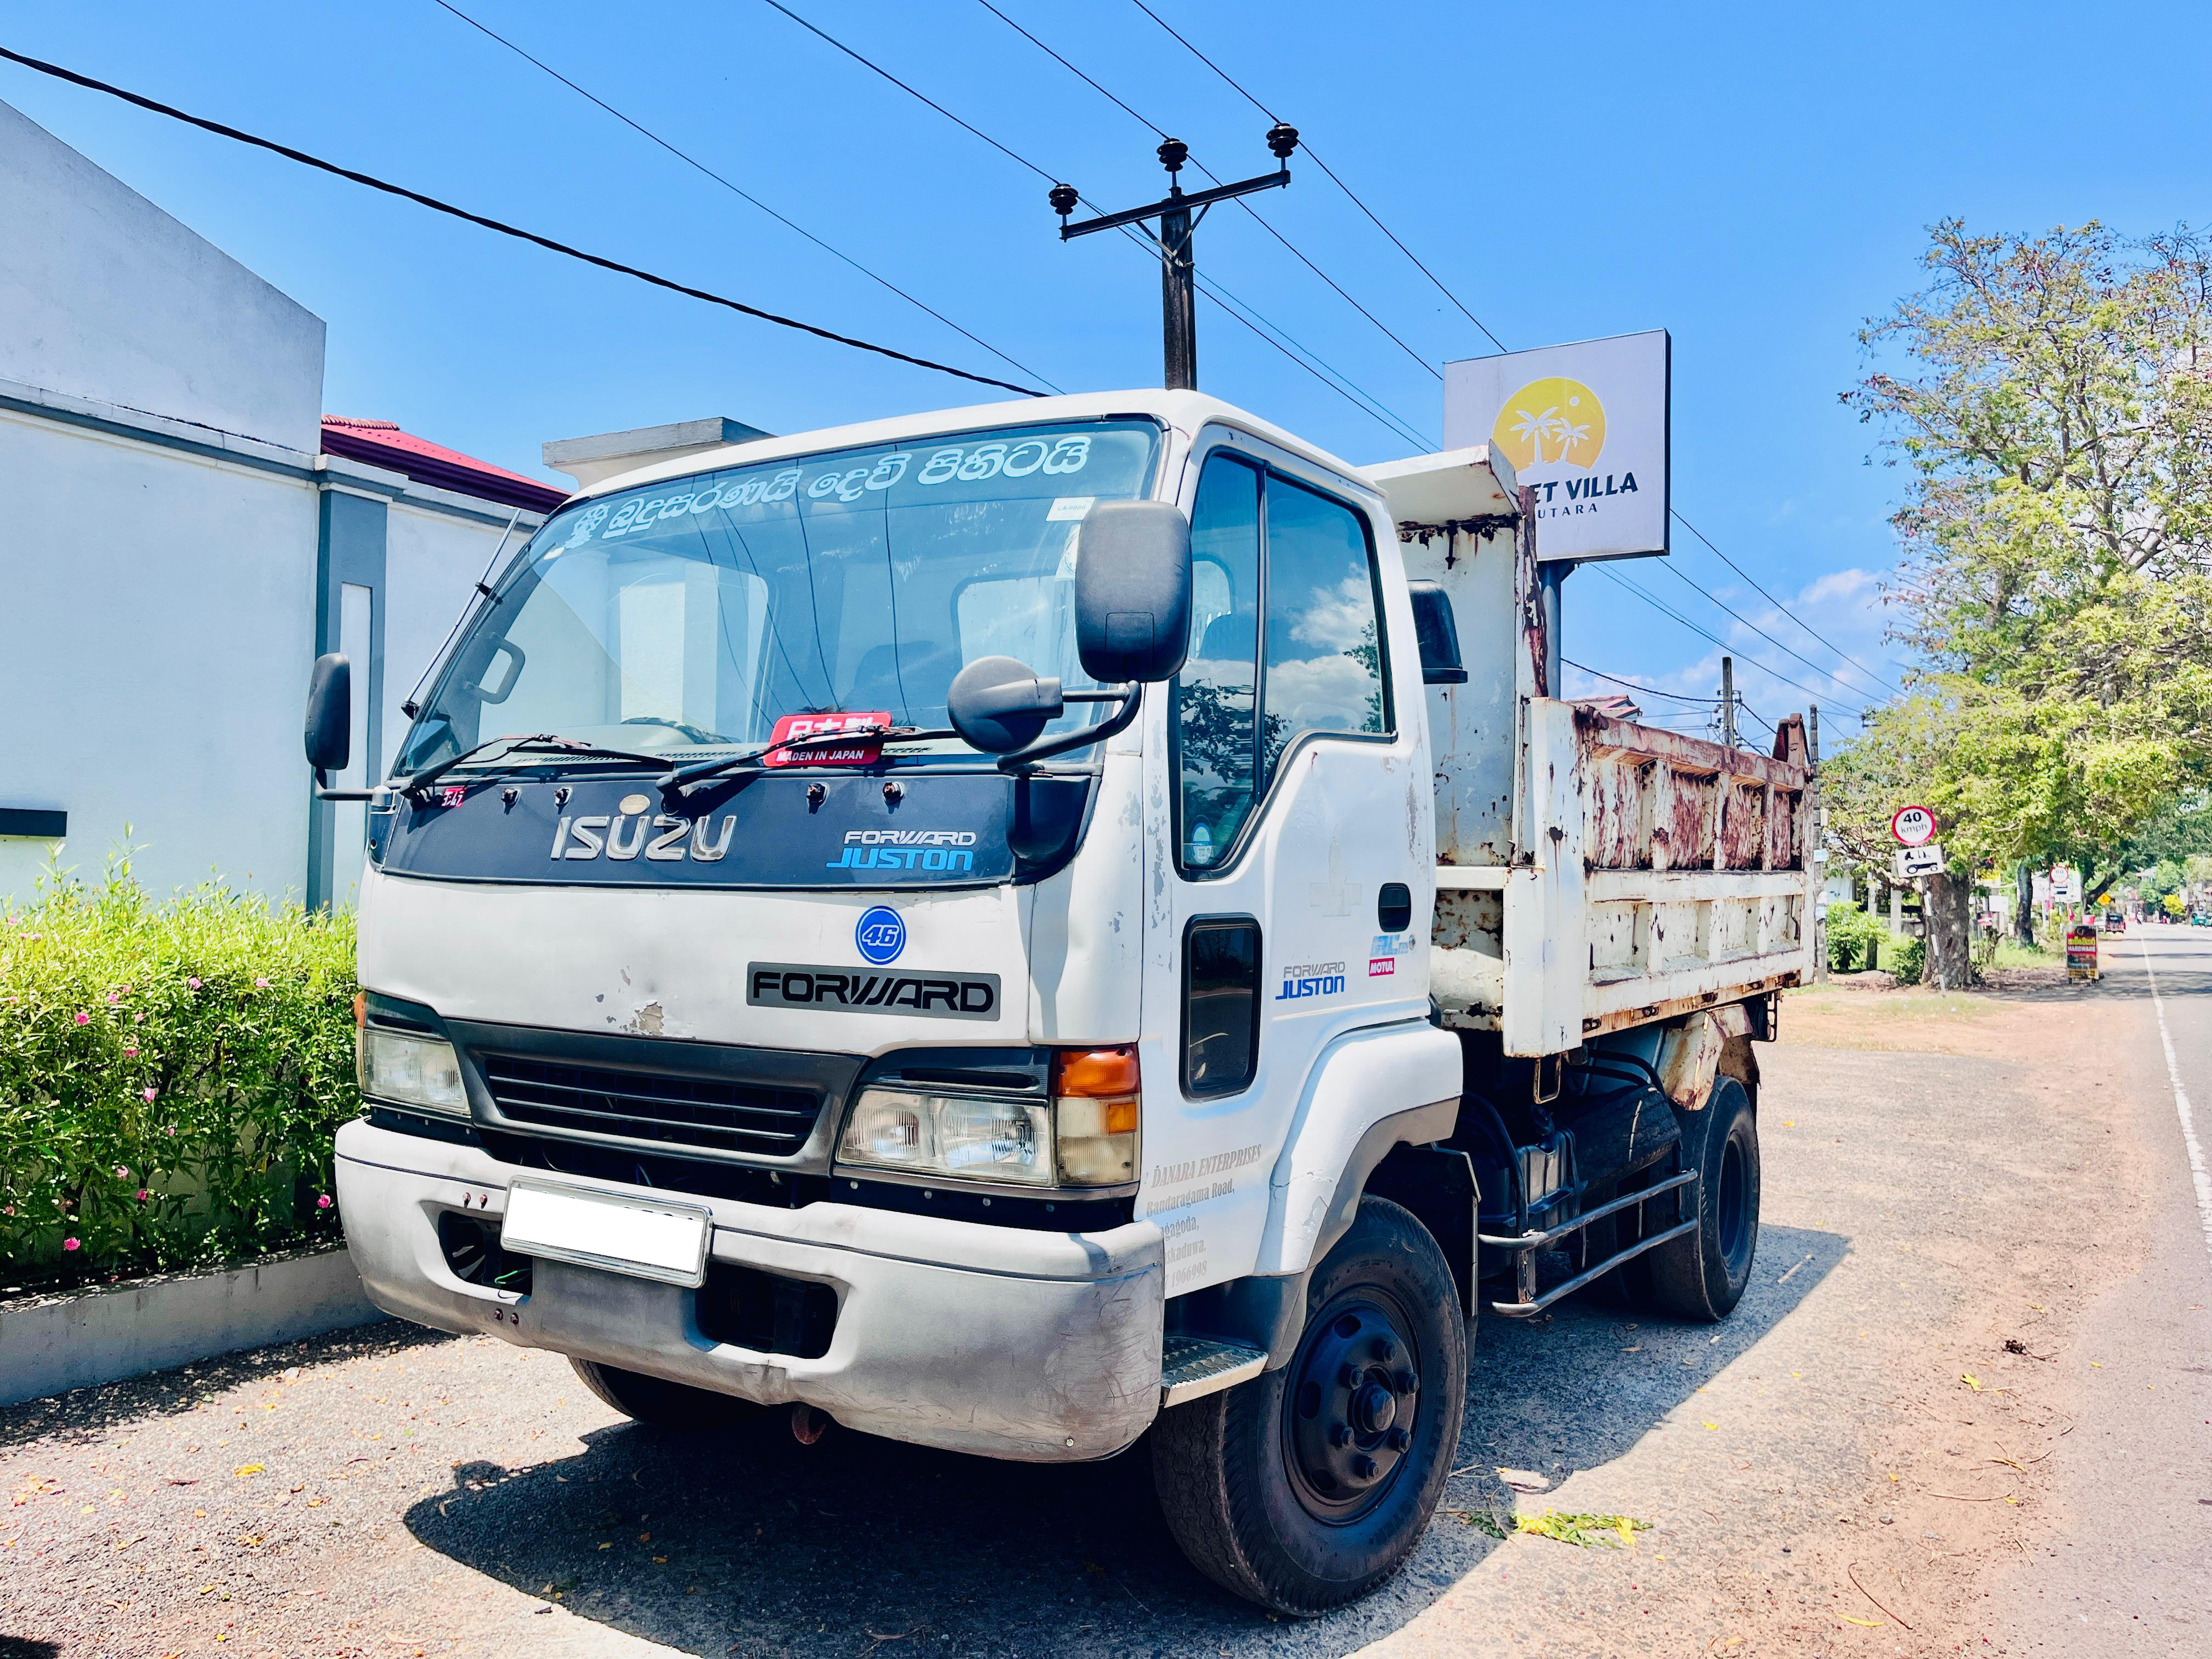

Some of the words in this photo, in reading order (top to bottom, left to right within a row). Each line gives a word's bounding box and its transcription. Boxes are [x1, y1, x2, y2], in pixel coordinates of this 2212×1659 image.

[807, 453, 912, 502] දෙවි
[917, 436, 1091, 485] පිහිටයි
[1529, 481, 1558, 503] ET
[1566, 472, 1639, 500] VILLA
[1538, 503, 1598, 519] UTARA
[776, 751, 813, 762] MADEN
[815, 751, 827, 760] IN
[829, 750, 864, 760] JAPAN
[1901, 823, 1927, 833] kmph
[1903, 812, 1922, 823] 40
[550, 813, 737, 861] ISUZU
[844, 830, 977, 846] FORWARD
[826, 847, 974, 872] JUSTON
[861, 924, 900, 947] 46
[1284, 962, 1345, 978] FORWARD
[1369, 961, 1394, 974] MOTUL
[753, 971, 994, 1013] FORWARD
[1151, 1161, 1195, 1188] DANARA
[1197, 1144, 1262, 1177] ENTERPRISES
[1146, 1187, 1209, 1218] Bandaragama
[1211, 1178, 1234, 1198] Road,
[1171, 1260, 1208, 1287] 1966998
